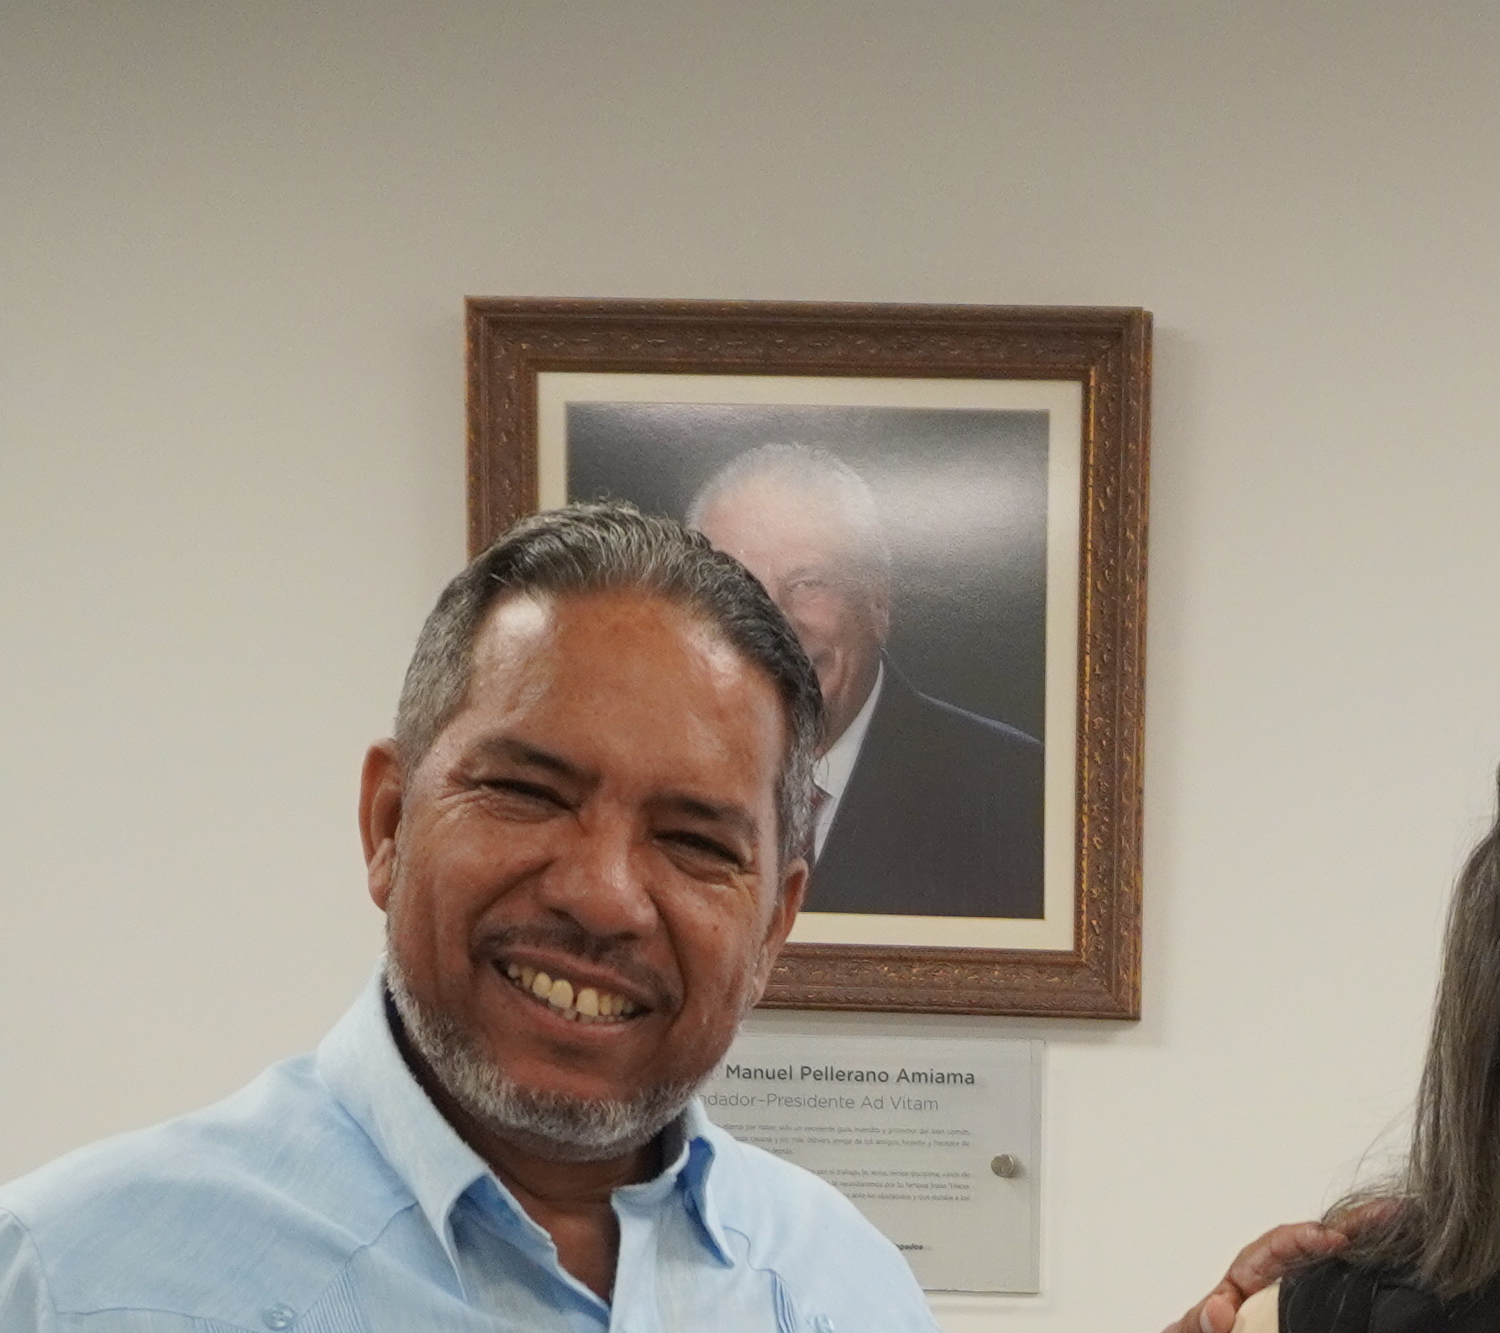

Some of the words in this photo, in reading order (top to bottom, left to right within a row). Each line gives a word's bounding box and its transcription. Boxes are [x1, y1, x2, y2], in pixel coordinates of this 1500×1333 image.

[726, 1064, 793, 1082] Manuel
[800, 1066, 889, 1084] Pellerano
[896, 1068, 975, 1085] Amiama
[861, 1095, 884, 1110] Ad
[892, 1096, 939, 1112] Vitam
